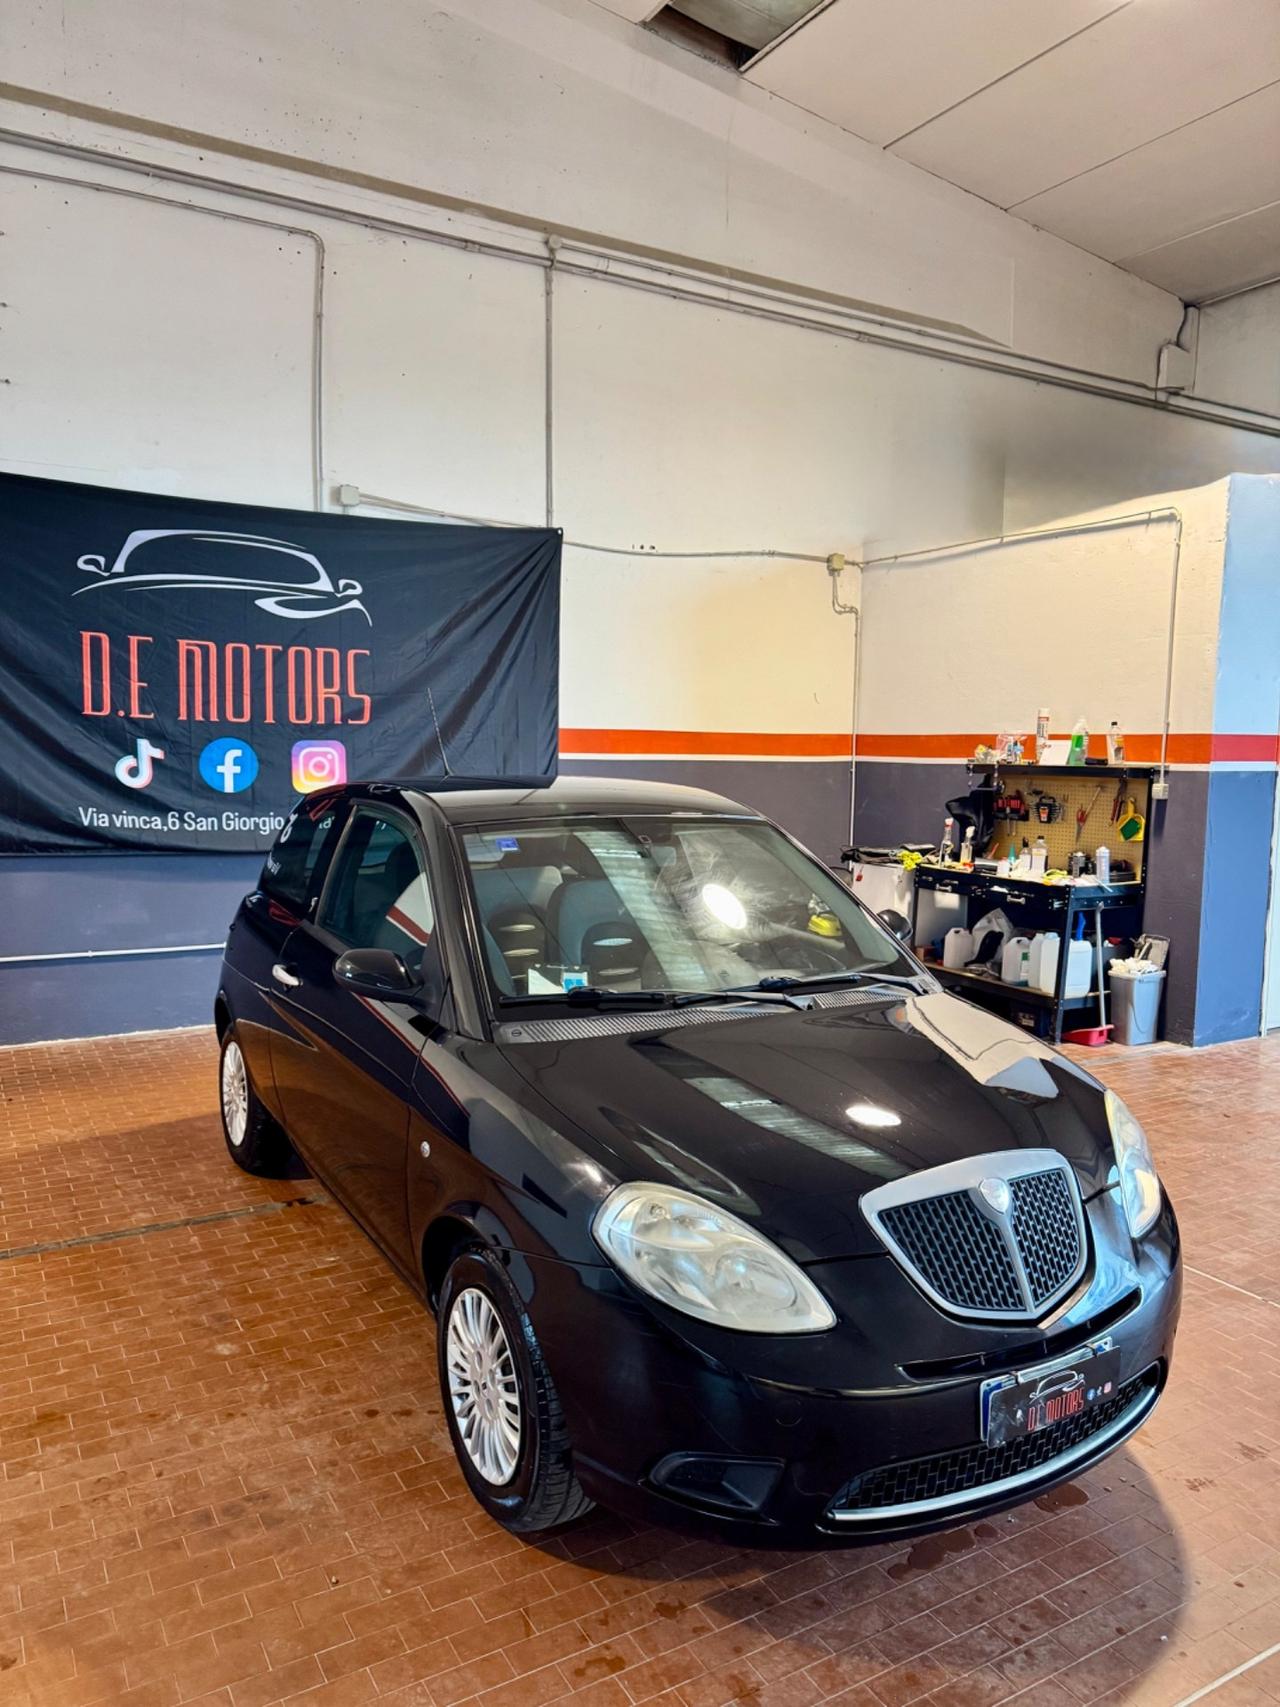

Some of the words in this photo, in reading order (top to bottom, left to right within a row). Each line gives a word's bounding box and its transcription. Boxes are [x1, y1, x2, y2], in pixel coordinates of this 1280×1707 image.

[79, 630, 155, 719] D.E
[176, 638, 372, 725] MOTORS
[78, 806, 110, 828] Via
[112, 810, 180, 833] vinca,6
[183, 811, 219, 831] San
[222, 811, 285, 836] Giorgio
[1046, 1388, 1085, 1423] MOTORS
